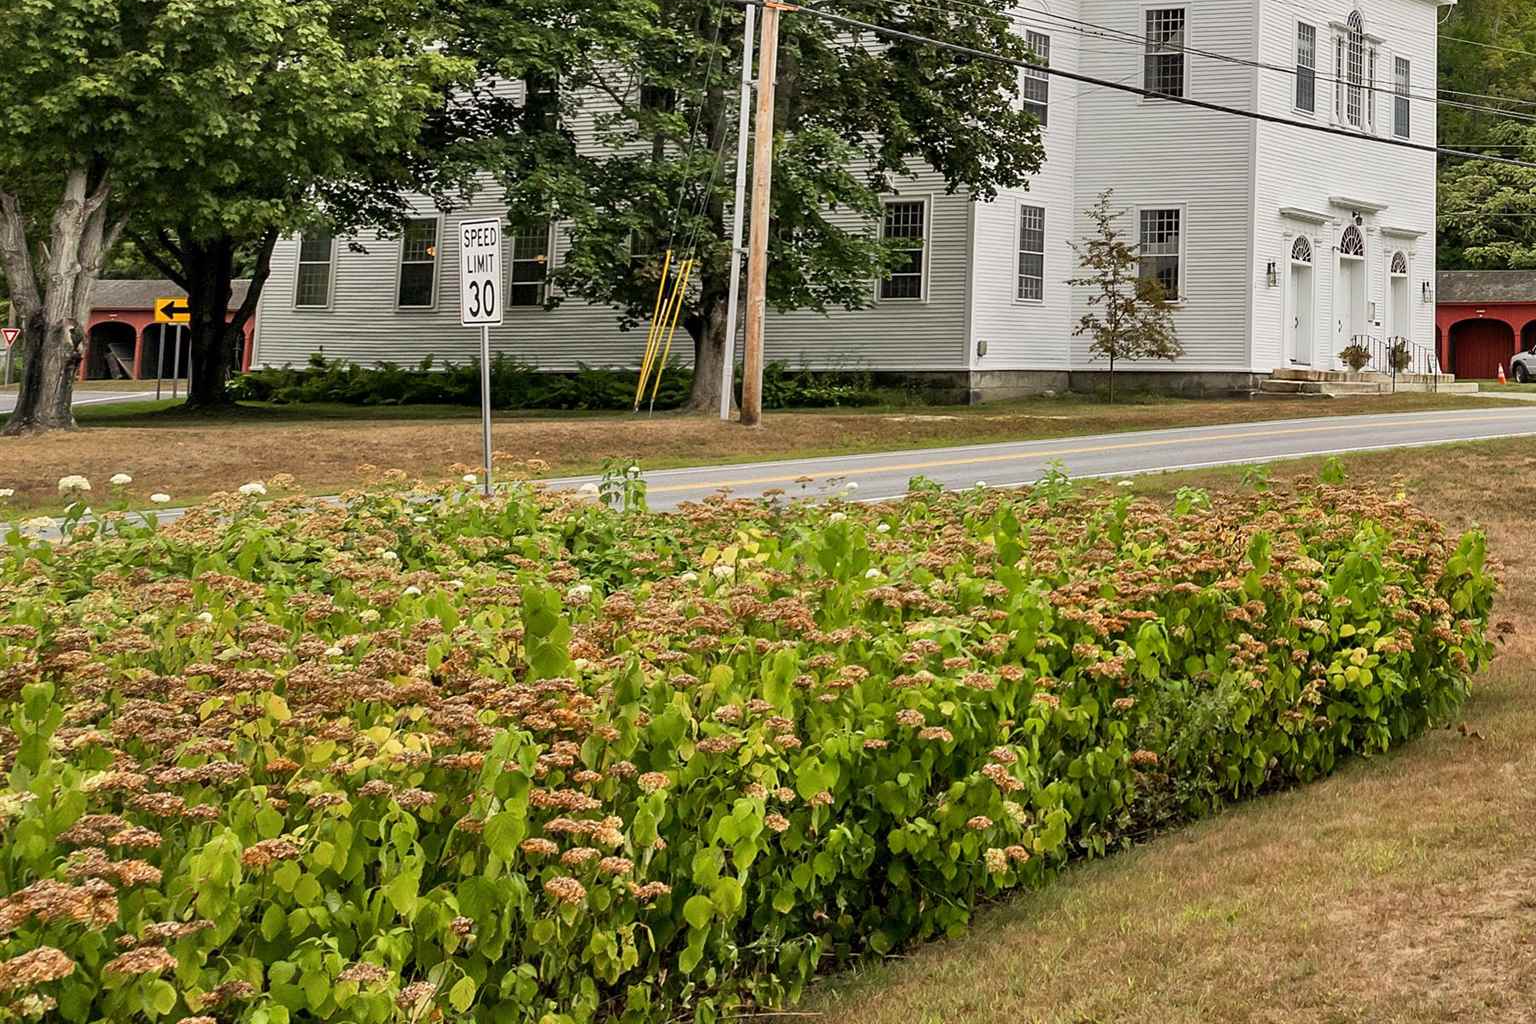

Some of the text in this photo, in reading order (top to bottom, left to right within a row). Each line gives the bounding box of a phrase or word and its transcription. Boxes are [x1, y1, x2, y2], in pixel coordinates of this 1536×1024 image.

[463, 227, 497, 248] SPEED
[467, 253, 494, 274] LIMIT
[469, 279, 495, 317] 30
